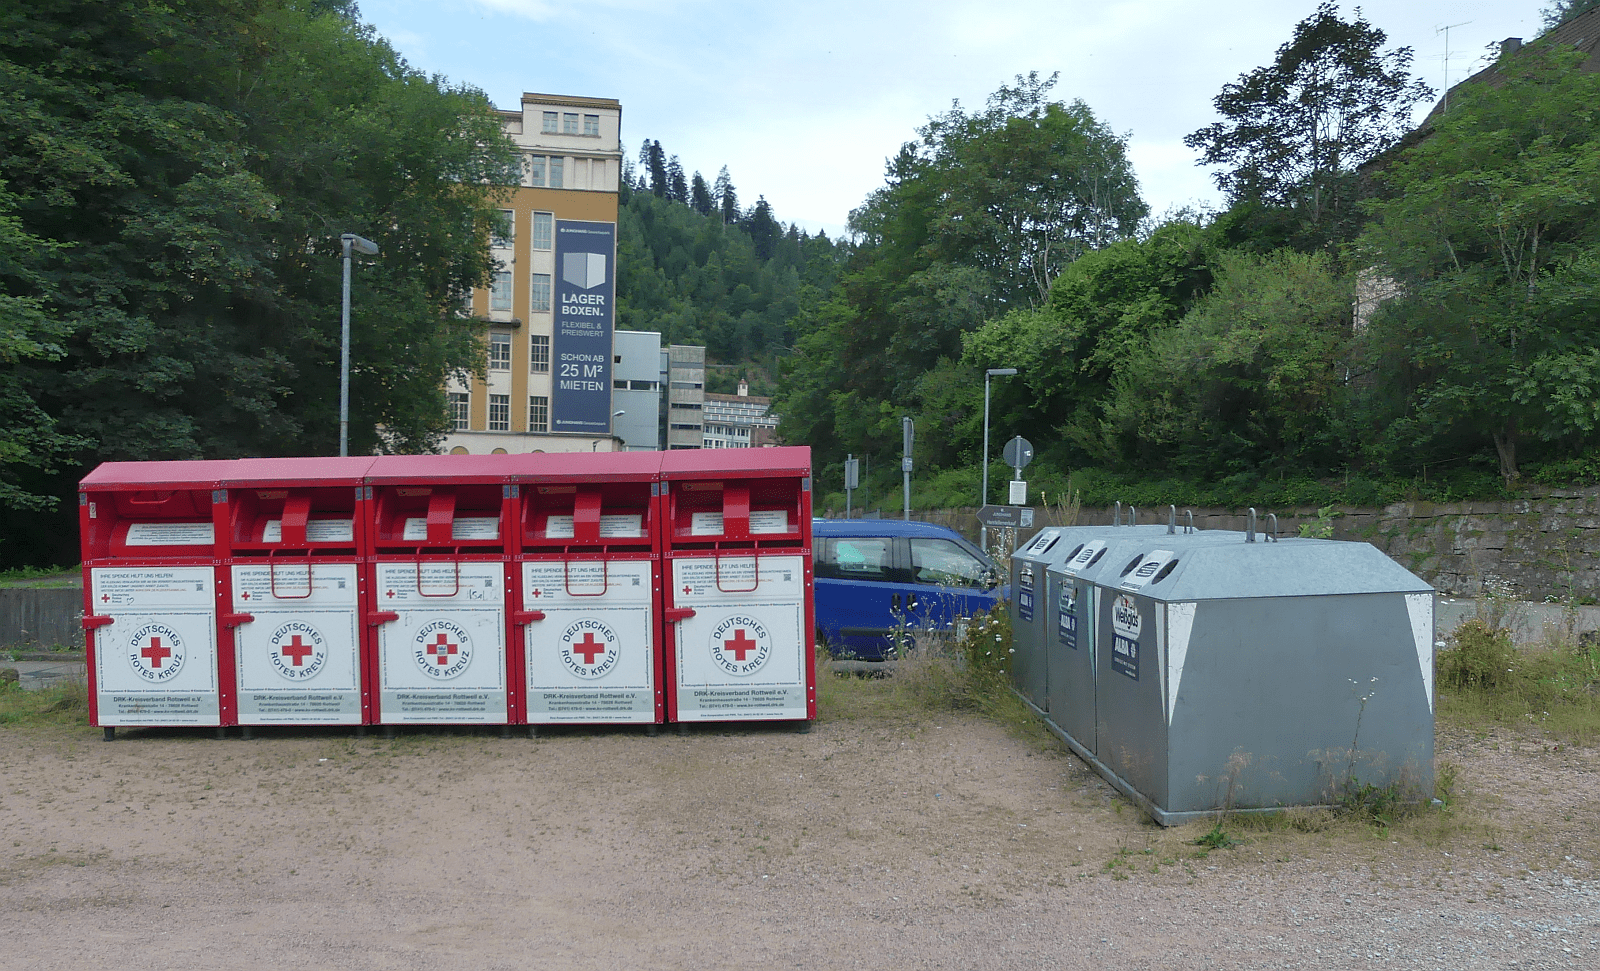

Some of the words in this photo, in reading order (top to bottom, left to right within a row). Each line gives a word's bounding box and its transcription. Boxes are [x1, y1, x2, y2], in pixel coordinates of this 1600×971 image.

[562, 294, 604, 304] LAGER
[562, 306, 604, 316] BOXEN.
[562, 321, 595, 329] FLEXIBEL
[560, 353, 591, 361] SCHON
[560, 364, 579, 377] 25
[584, 364, 603, 378] M²
[560, 380, 603, 391] MIETEN
[713, 616, 766, 640] DEUTSCHES
[1115, 606, 1138, 629] Weißglas
[130, 625, 180, 647] DEUTSCHES
[271, 623, 322, 645] DEUTSCHES
[416, 621, 468, 643] DEUTSCHES
[562, 620, 615, 643] DEUTSCHES
[1115, 637, 1129, 656] ALBA
[130, 654, 154, 679] ROTES
[158, 654, 183, 679] KREUZ
[271, 652, 296, 677] ROTES
[299, 652, 325, 678] KREUZ
[415, 651, 440, 676] ROTES
[444, 651, 470, 676] KREUZ
[562, 650, 587, 676] ROTES
[590, 650, 617, 676] KREUZ
[713, 646, 738, 673] ROTES
[742, 646, 769, 672] KREUZ
